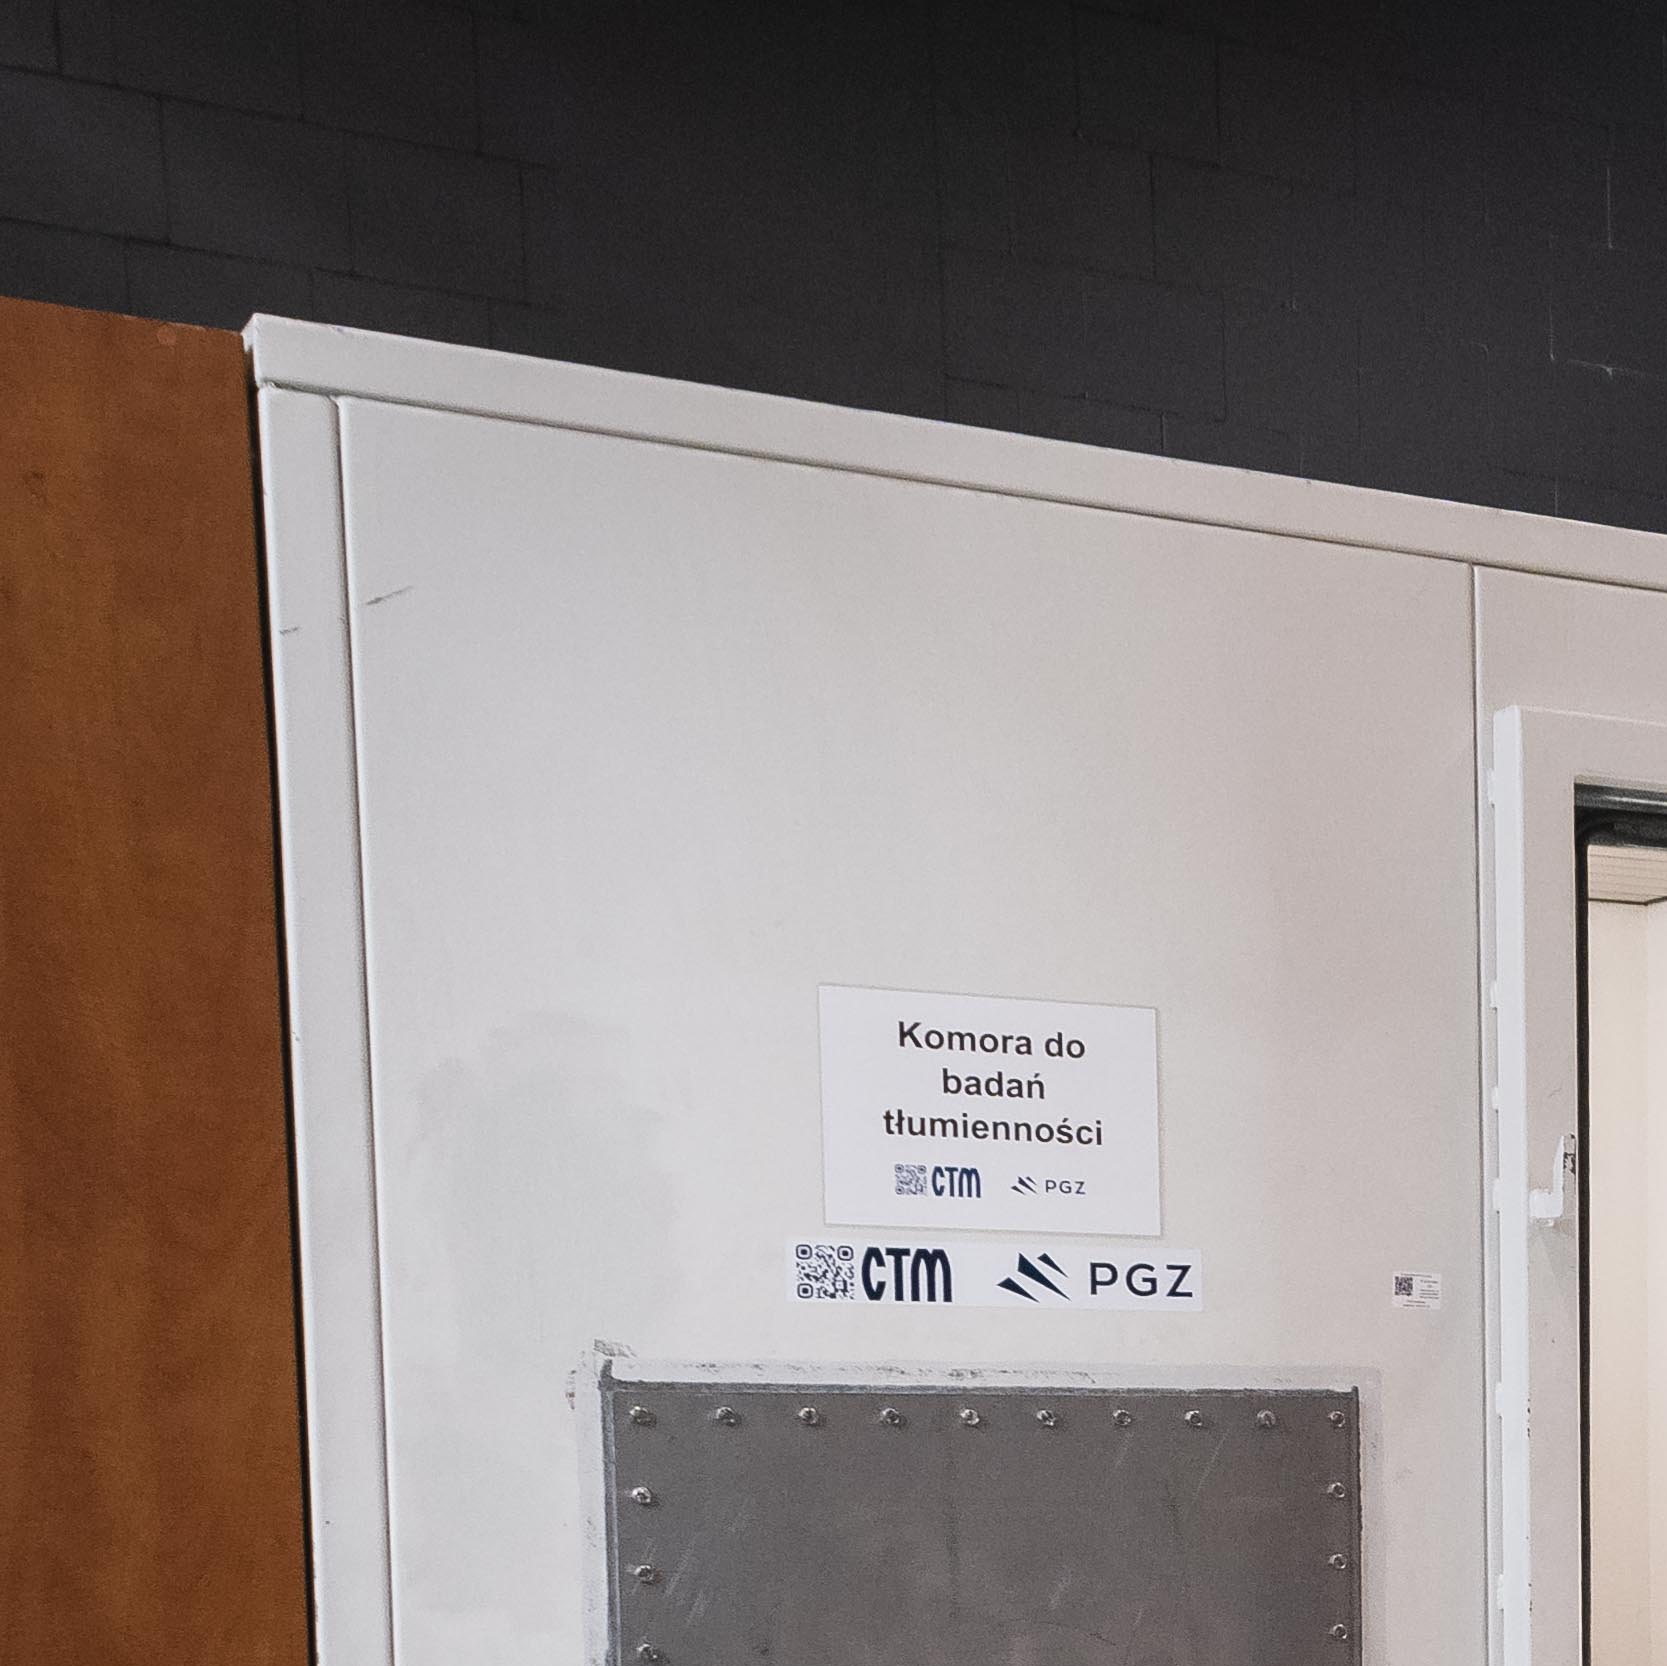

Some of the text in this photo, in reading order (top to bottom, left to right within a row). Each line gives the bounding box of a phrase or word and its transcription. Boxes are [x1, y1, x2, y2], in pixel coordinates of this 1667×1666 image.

[898, 1021, 1086, 1058] Komora do
[942, 1068, 1045, 1099] badań
[883, 1109, 1102, 1145] tłumienności
[931, 1166, 981, 1198] CTM
[1045, 1180, 1086, 1195] PGZ
[861, 1247, 952, 1302] CTM
[1089, 1262, 1193, 1298] PGZ
